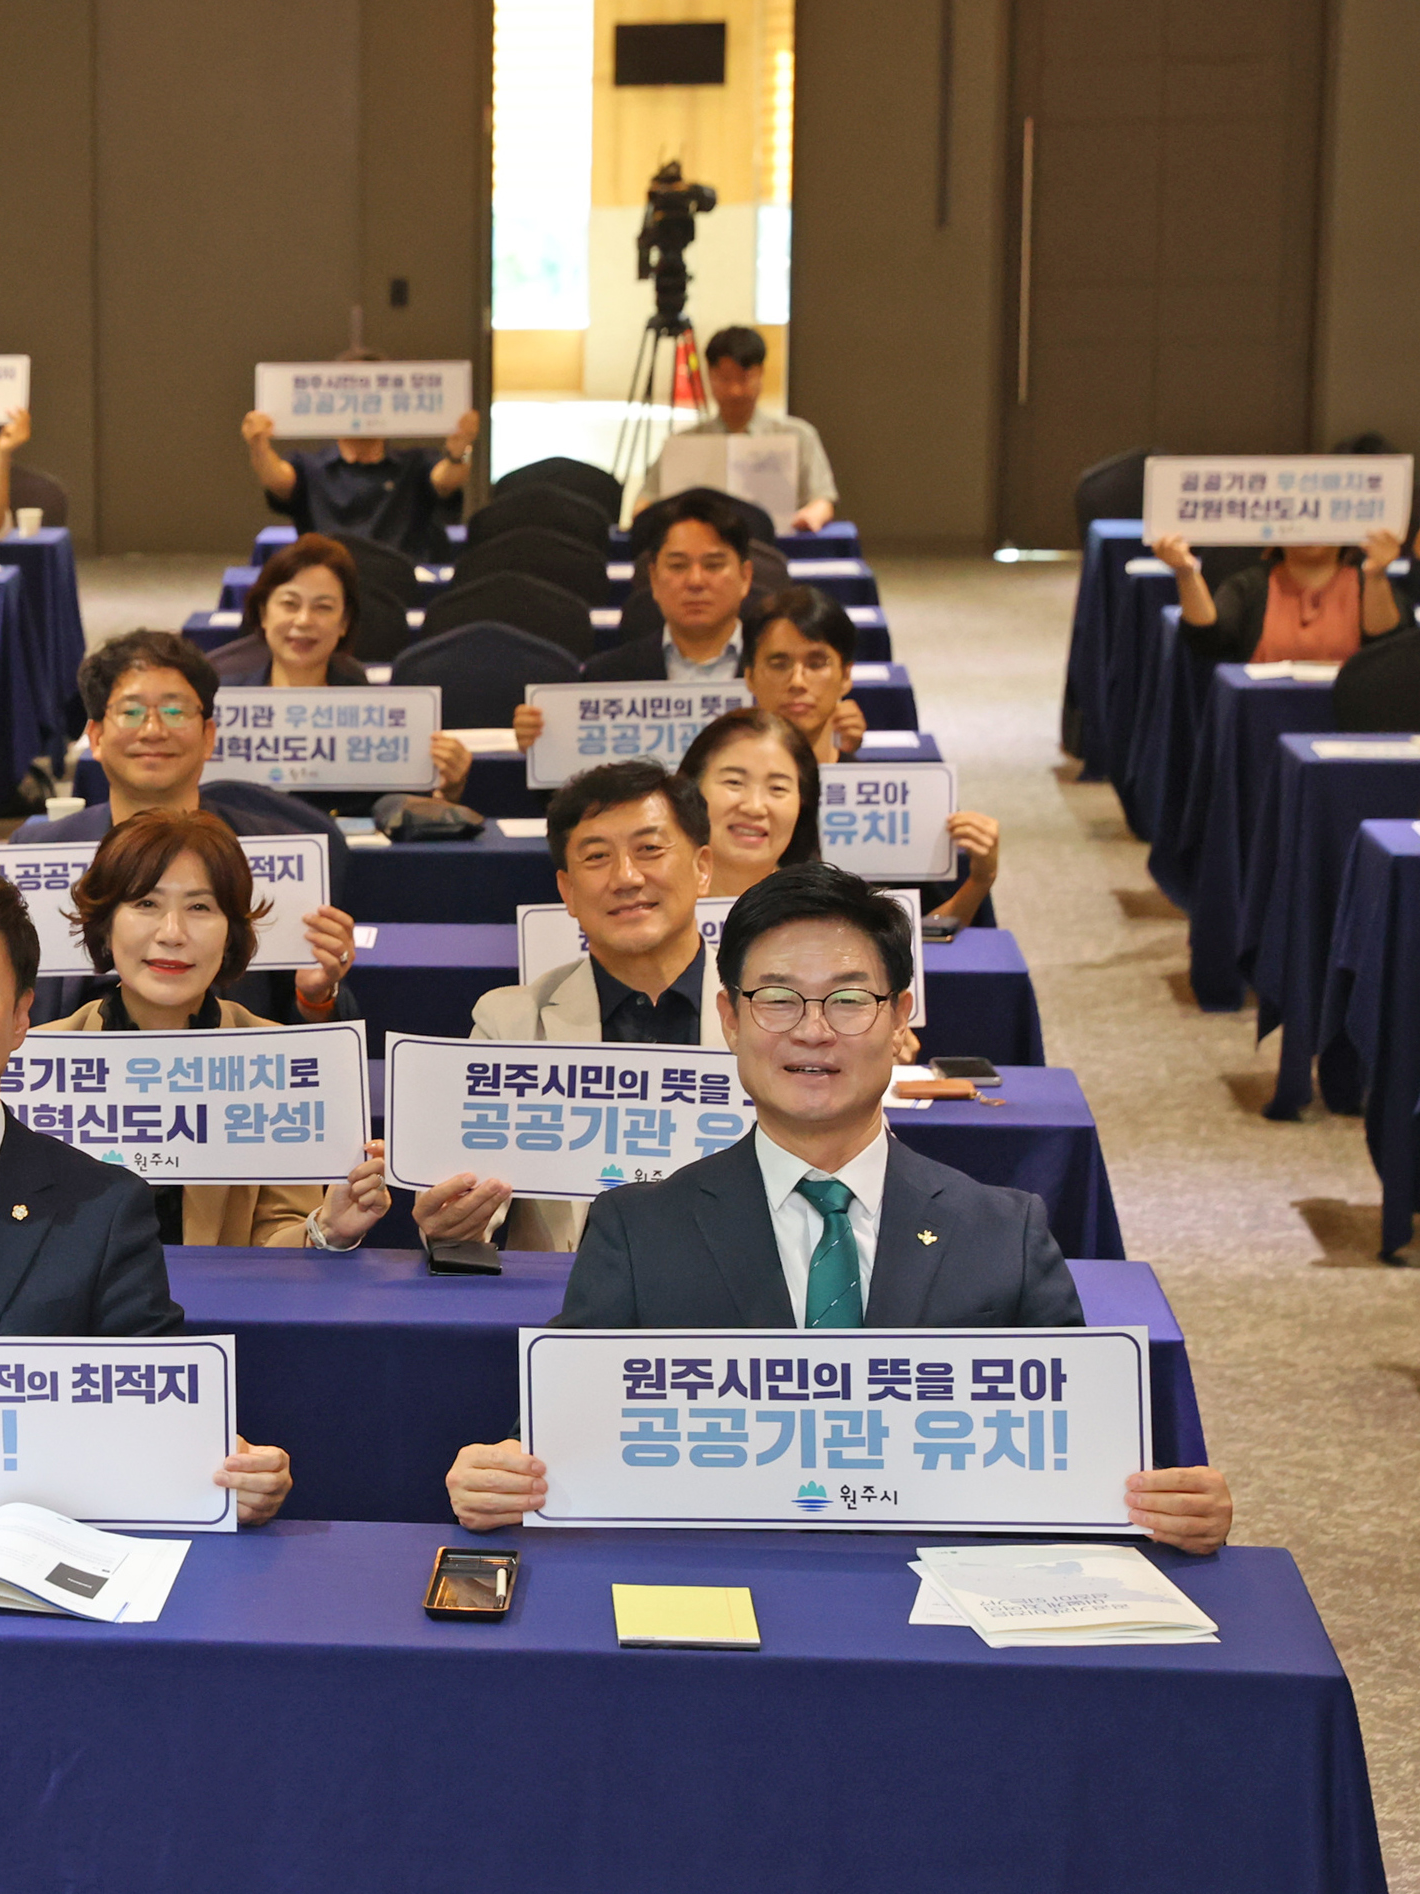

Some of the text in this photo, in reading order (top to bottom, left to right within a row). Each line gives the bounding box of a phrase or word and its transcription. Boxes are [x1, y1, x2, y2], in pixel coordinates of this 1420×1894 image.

[212, 703, 408, 730] 기관 우선배치로
[580, 697, 693, 721] 원주시민의
[346, 735, 410, 764] 완성!
[856, 780, 910, 806] 모아
[823, 810, 910, 845] 유치!
[248, 853, 304, 883] 적지
[0, 1053, 320, 1094] 공기관 우선배치로
[465, 1061, 731, 1106] 원주시민의 뜻을
[223, 1100, 325, 1144] 완성!
[460, 1101, 677, 1158] 공공기관
[133, 1152, 180, 1173] 원주시
[70, 1362, 199, 1405] 최적지
[621, 1357, 1068, 1403] 원주시민의 뜻을 모아
[619, 1407, 1069, 1472] 공공기관 유치!
[839, 1483, 900, 1509] 원주시
